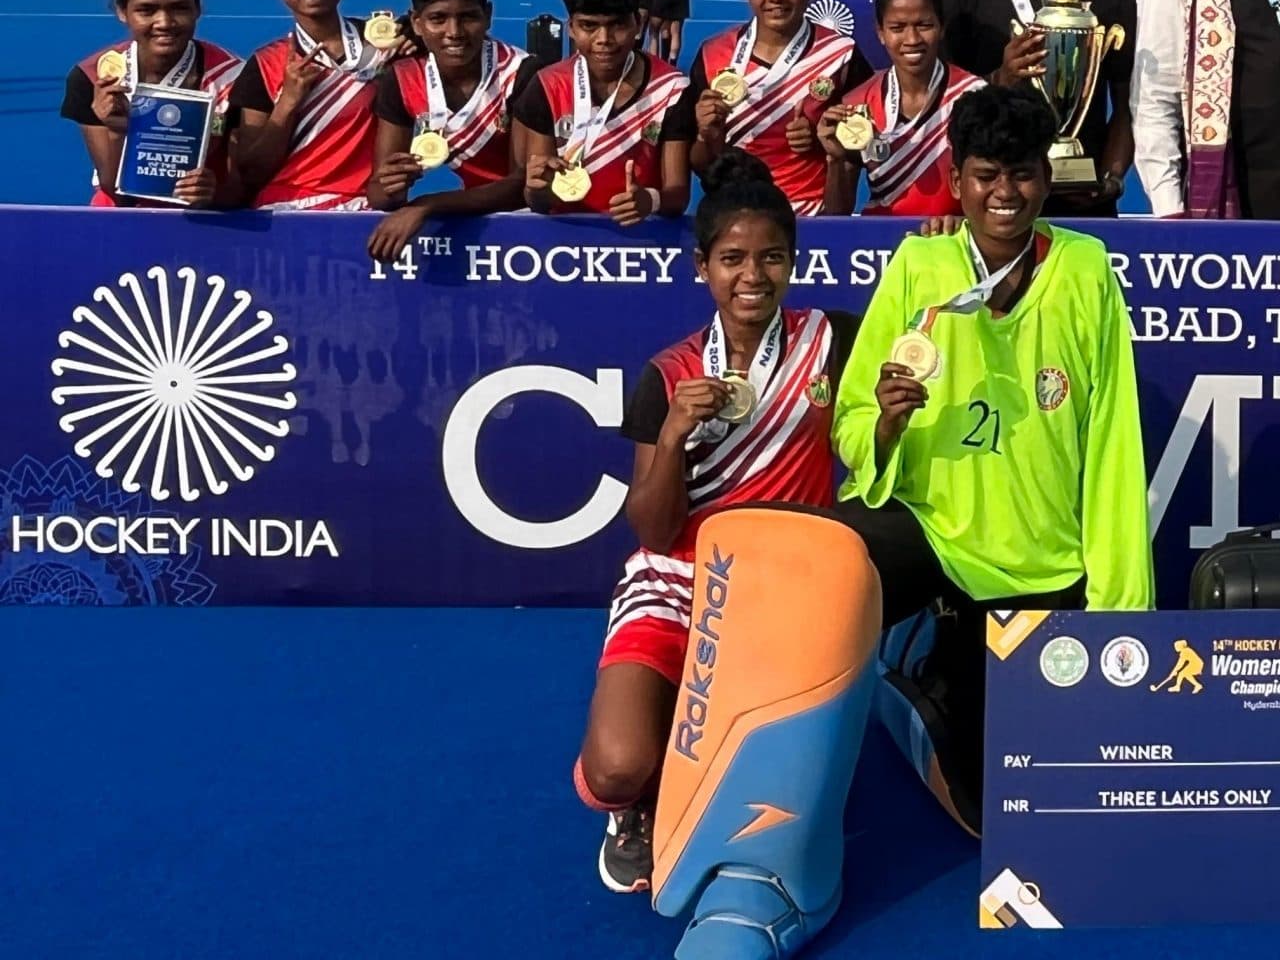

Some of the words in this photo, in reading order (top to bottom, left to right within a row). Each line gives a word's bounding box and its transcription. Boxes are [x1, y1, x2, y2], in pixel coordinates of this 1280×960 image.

[137, 151, 189, 165] PLAYER
[369, 236, 452, 280] 14TH
[466, 245, 682, 283] HOCKEY
[961, 399, 1002, 455] 21
[12, 515, 200, 556] HOCKEY
[211, 518, 339, 557] INDIA
[675, 542, 735, 763] Rakshak
[1235, 639, 1276, 651] HOCKEY
[1100, 745, 1173, 760] WINNER
[1004, 755, 1031, 768] PAY
[1003, 799, 1029, 813] INR
[1099, 791, 1156, 807] THREE
[1161, 790, 1220, 806] LAKHS
[1224, 789, 1271, 805] ONLY
